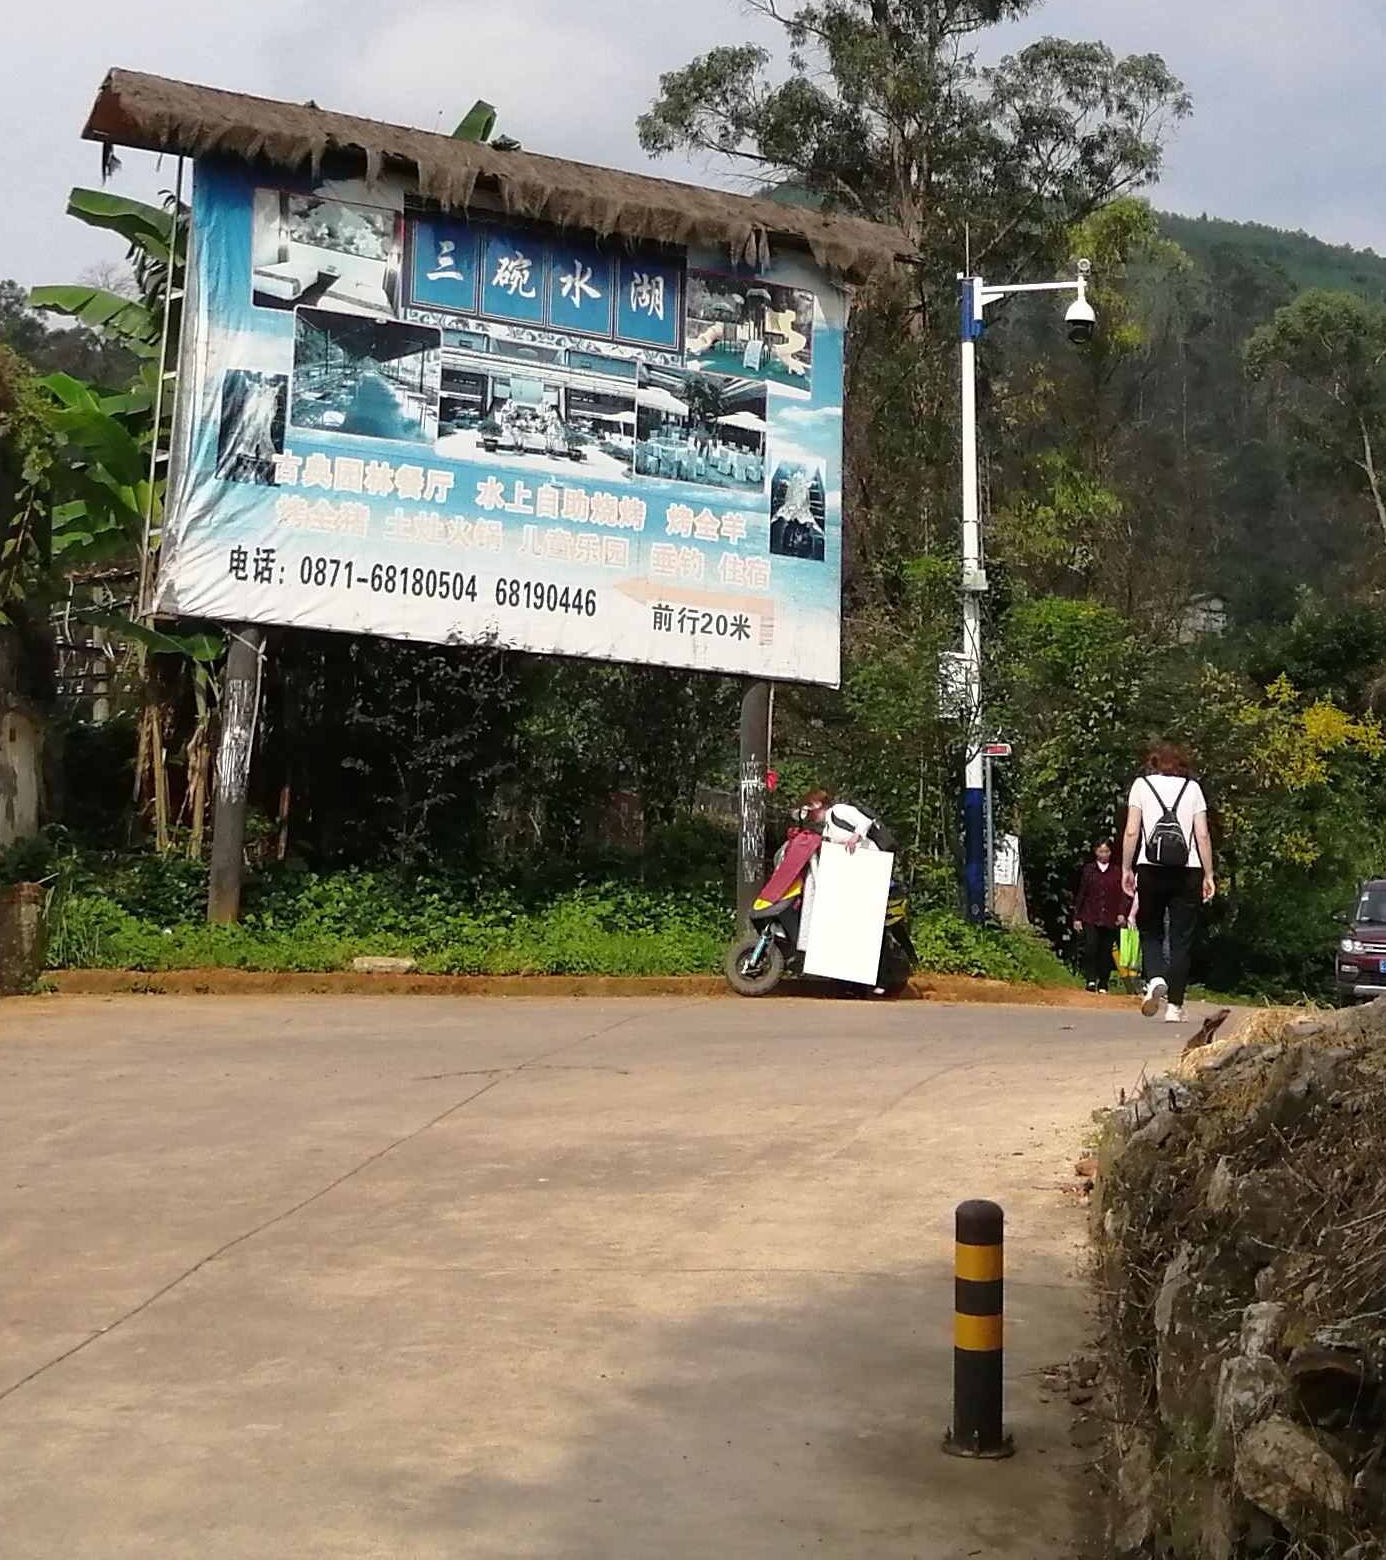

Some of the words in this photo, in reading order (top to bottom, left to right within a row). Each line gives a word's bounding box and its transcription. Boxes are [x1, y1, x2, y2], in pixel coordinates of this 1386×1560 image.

[426, 240, 664, 320] 三碗水湖
[272, 449, 454, 503] 古典园林餐厅
[475, 476, 646, 531] 水上自助烧烤
[666, 503, 747, 544] 烤全羊
[517, 524, 629, 569] 儿童乐园
[650, 542, 704, 581] 垂钓
[718, 551, 770, 589] 住宿
[496, 577, 596, 617] 68190446
[652, 602, 752, 641] 前行20米
